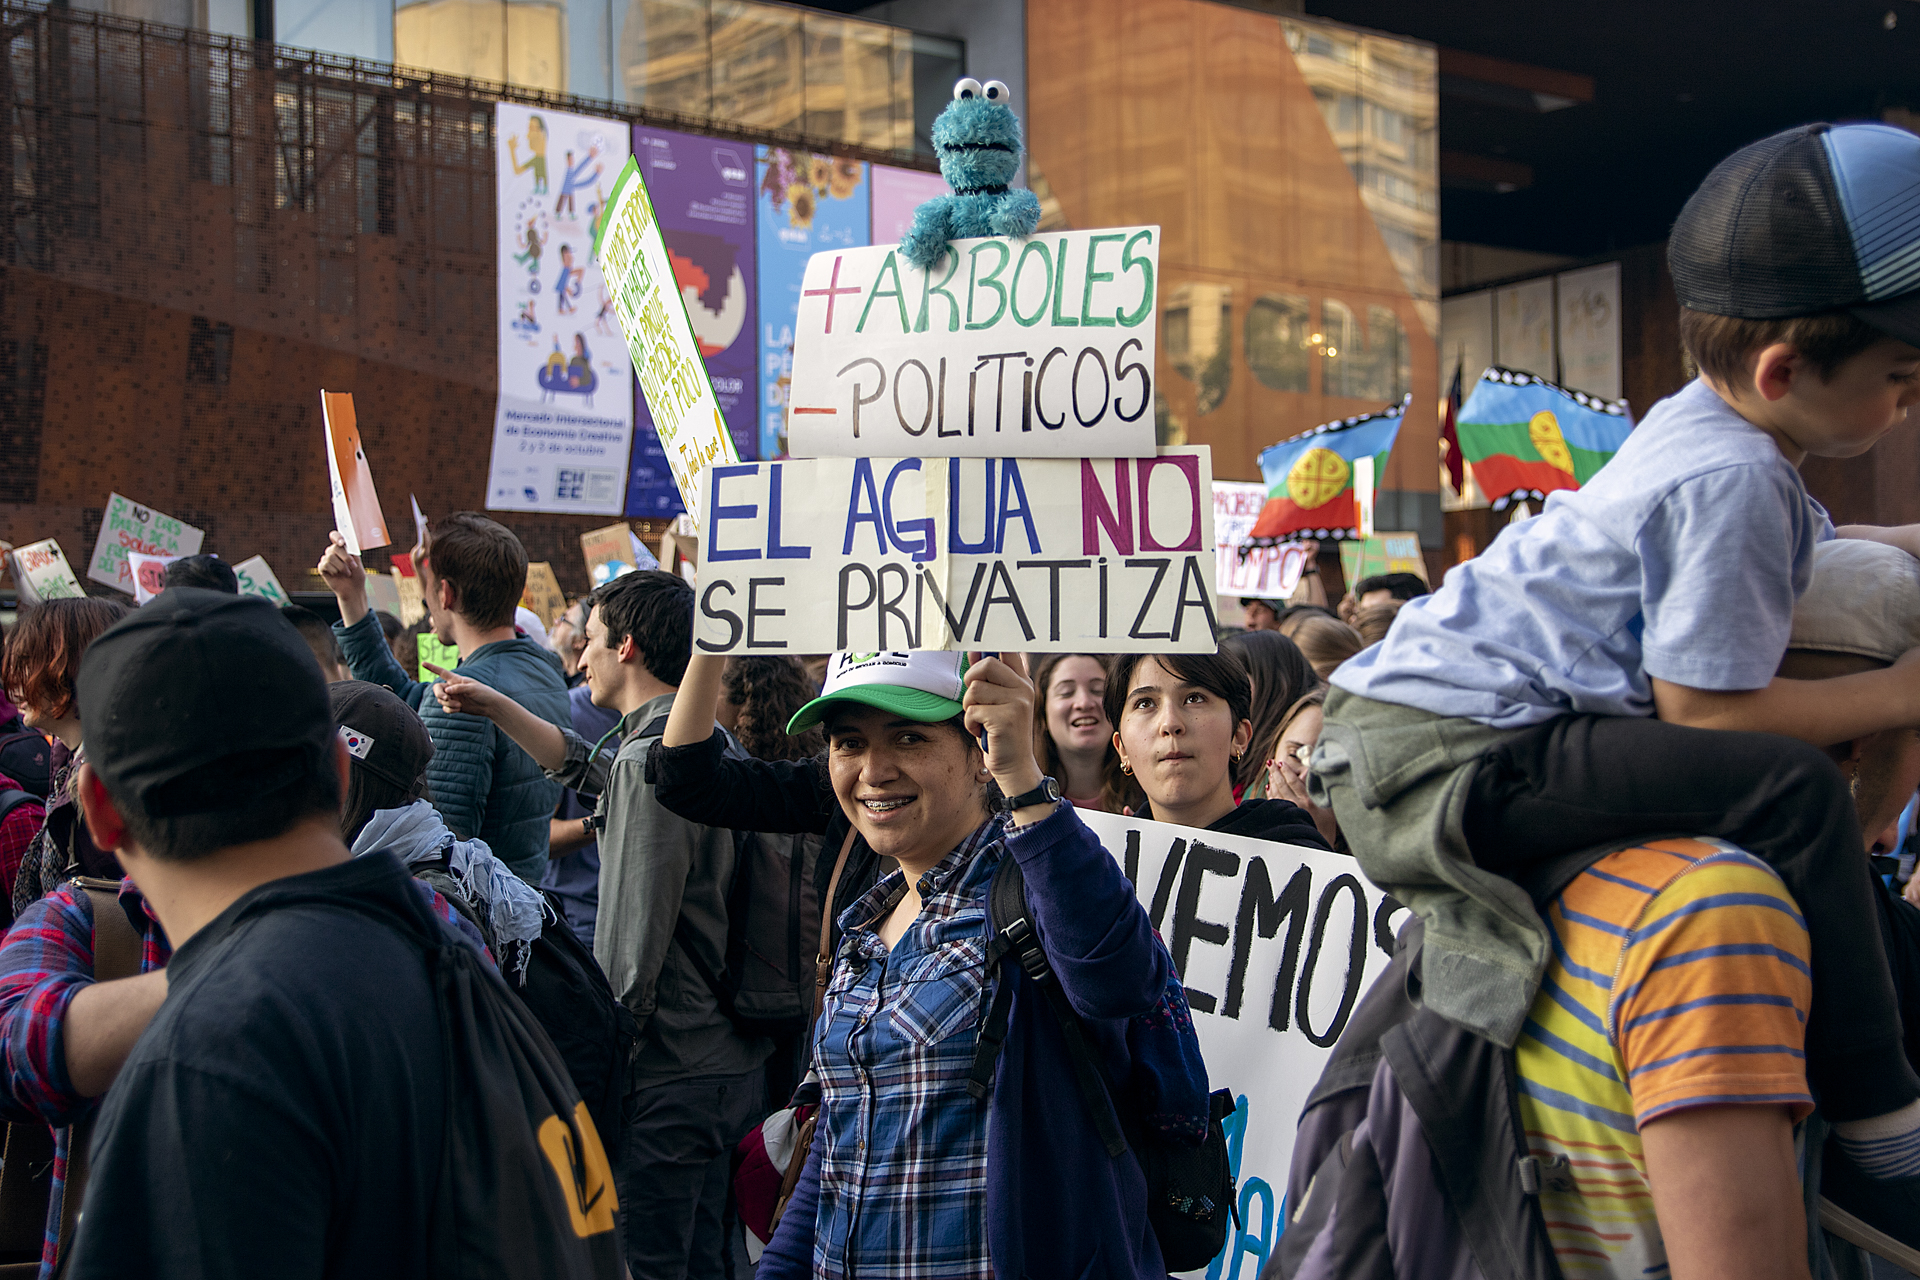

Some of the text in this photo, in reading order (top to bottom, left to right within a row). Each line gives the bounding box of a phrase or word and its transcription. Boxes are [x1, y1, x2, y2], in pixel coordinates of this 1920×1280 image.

[621, 183, 653, 251] ERROR
[855, 229, 1153, 334] ARBOLES
[649, 323, 681, 393] PUEDES
[671, 356, 702, 417] POCO
[505, 410, 552, 424] Mercado
[132, 506, 151, 523] NO
[708, 463, 811, 562] EL
[842, 457, 1042, 562] AGUA
[1081, 455, 1203, 556] NO
[695, 576, 788, 653] SE
